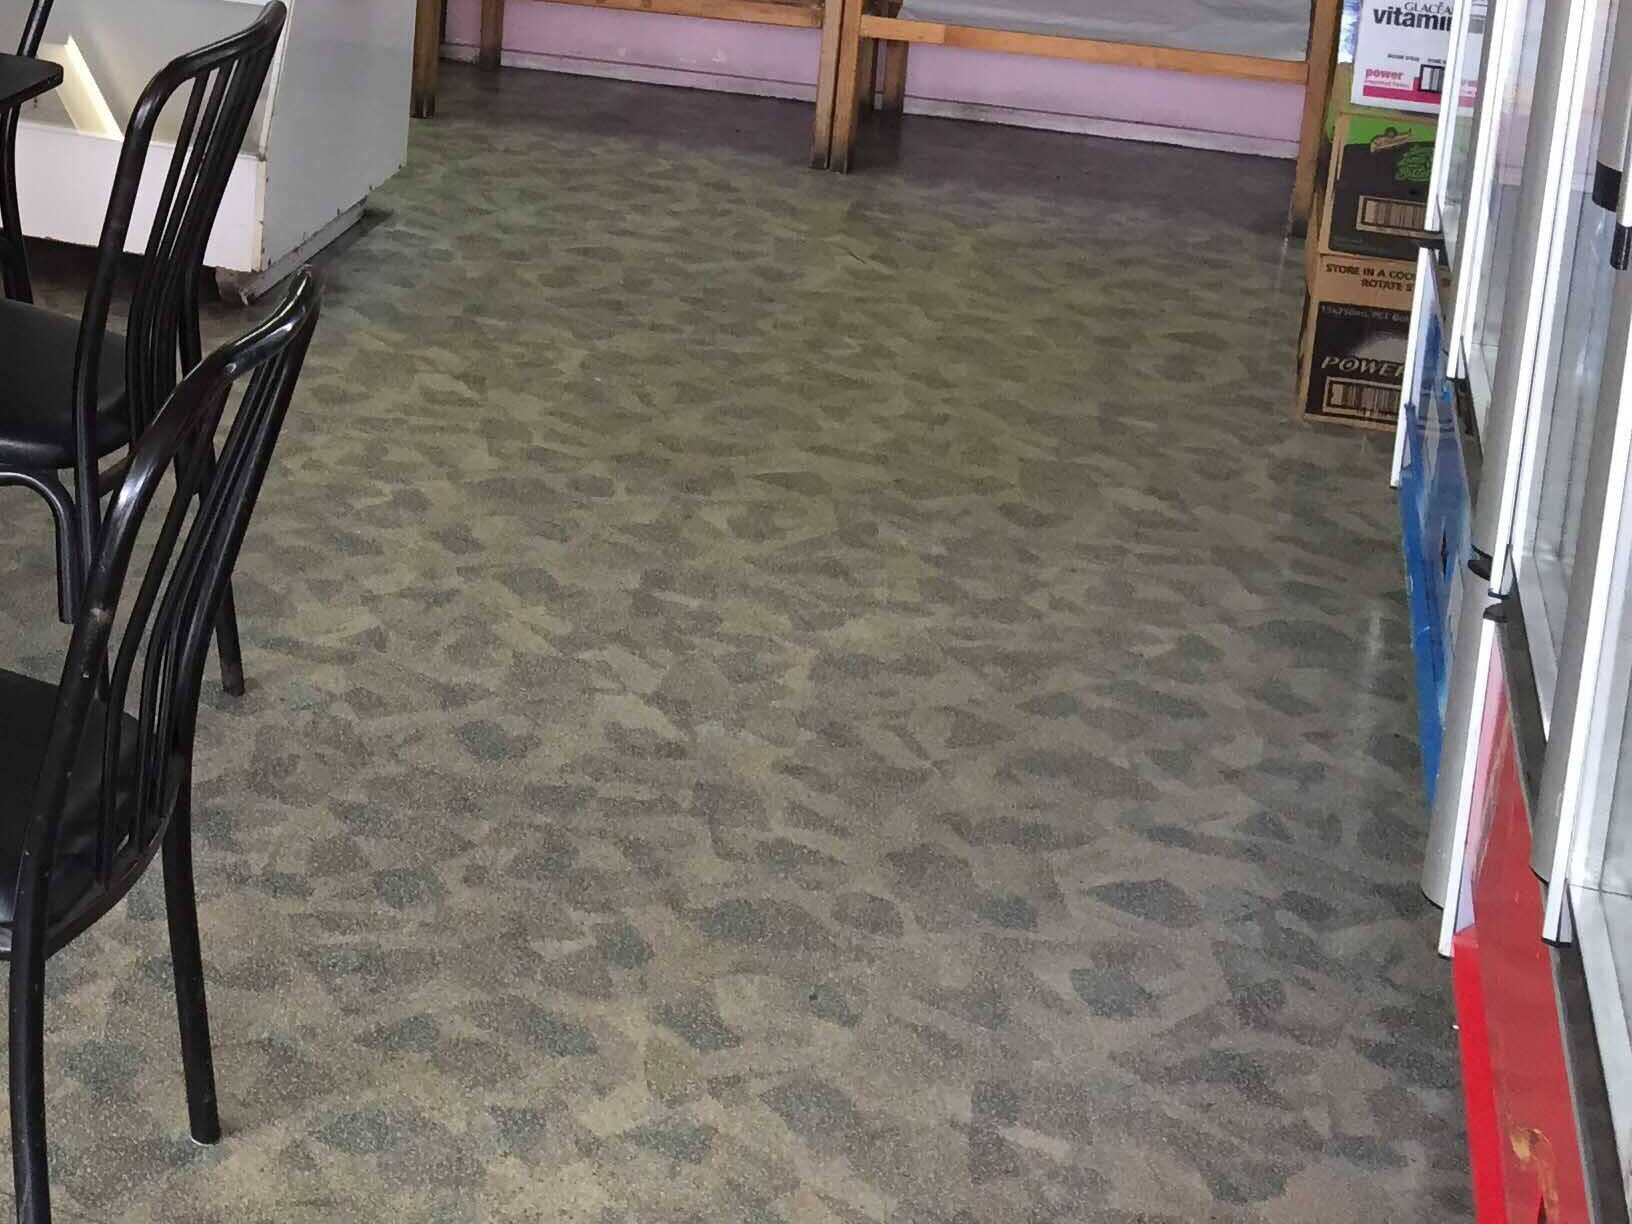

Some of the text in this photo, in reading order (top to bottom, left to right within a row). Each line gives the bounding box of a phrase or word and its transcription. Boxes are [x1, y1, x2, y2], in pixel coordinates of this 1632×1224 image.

[1365, 69, 1404, 81] power
[1326, 264, 1360, 276] STORE
[1363, 266, 1374, 277] IN
[1379, 269, 1388, 278] A
[1361, 279, 1403, 292] ROTATE
